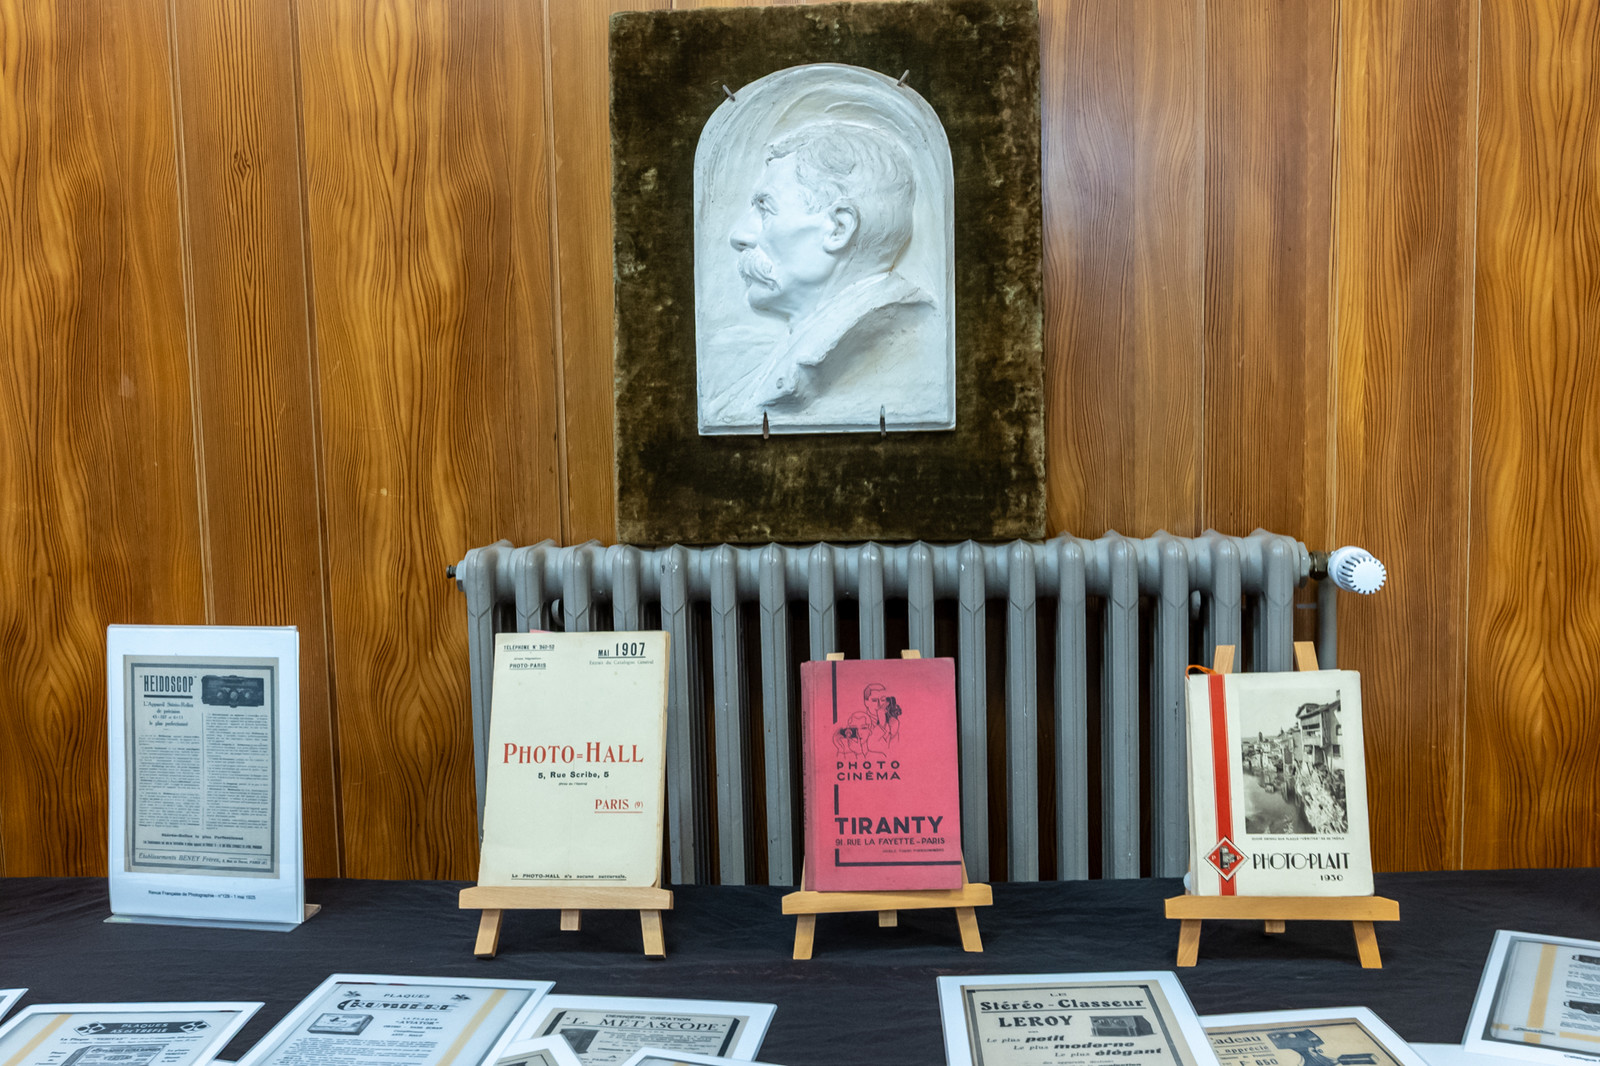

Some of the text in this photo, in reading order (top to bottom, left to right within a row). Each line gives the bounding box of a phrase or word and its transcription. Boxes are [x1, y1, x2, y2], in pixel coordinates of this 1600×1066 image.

[598, 642, 646, 657] MAI 1907
[836, 760, 901, 770] PHOTO
[550, 771, 566, 779] Rue
[836, 770, 901, 781] CINÉMA
[594, 799, 630, 810] PARIS
[834, 816, 944, 835] TIRANTY
[847, 838, 861, 846] RUE
[878, 837, 915, 845] FAYETTE
[921, 837, 945, 845] PARIS
[980, 1001, 1043, 1011] Stéréo
[1057, 999, 1145, 1009] Classeur
[998, 1015, 1073, 1028] LEROY
[1025, 1035, 1065, 1043] petit
[1054, 1042, 1135, 1050] moderne
